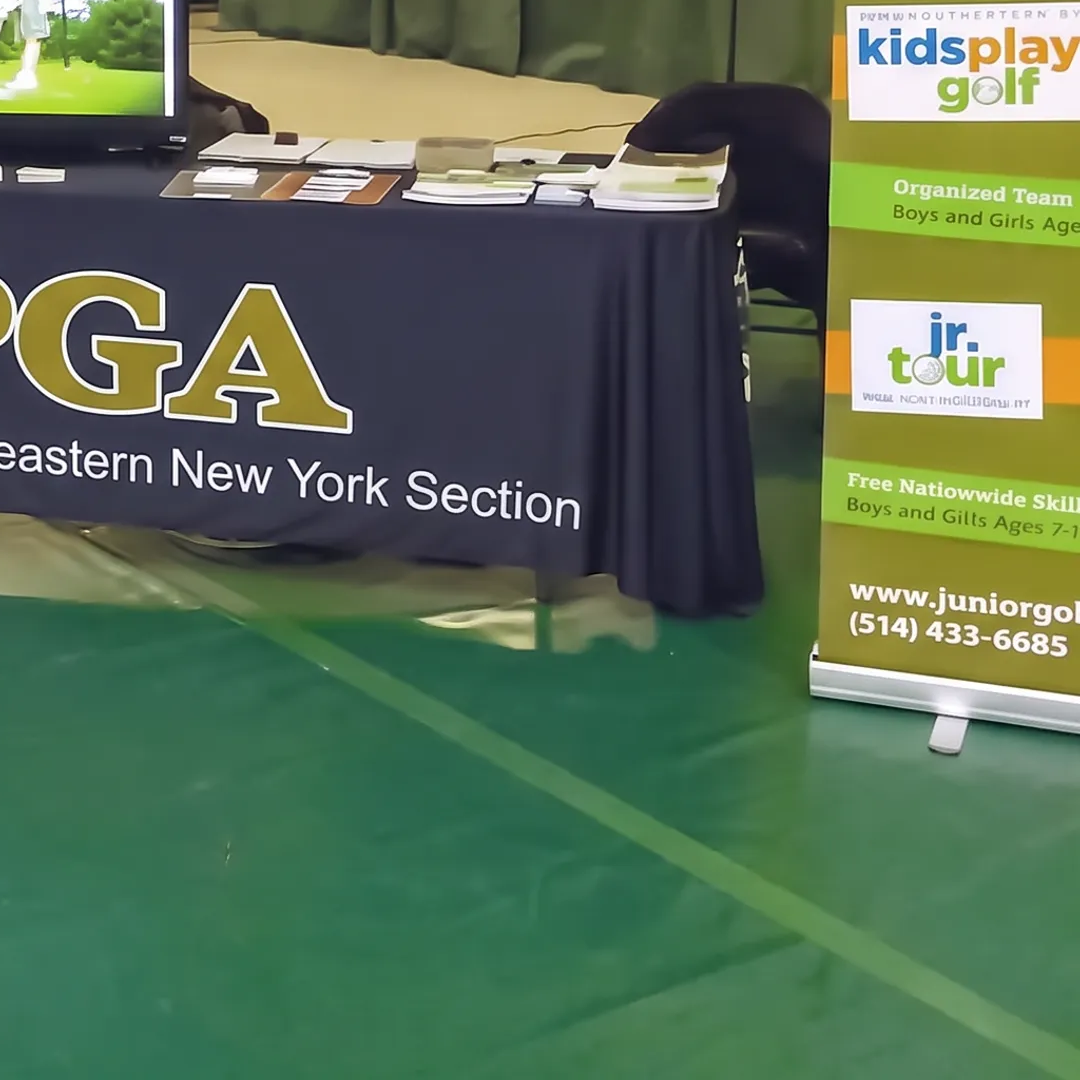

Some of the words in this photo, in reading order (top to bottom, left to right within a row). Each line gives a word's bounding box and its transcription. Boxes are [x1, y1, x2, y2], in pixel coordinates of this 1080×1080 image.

[858, 27, 1080, 72] kidsplay
[937, 67, 1040, 113] golf
[893, 179, 1006, 203] Organized
[1012, 187, 1073, 207] Team
[893, 204, 938, 225] Boys
[945, 211, 983, 226] and
[989, 213, 1034, 230] Girls
[1042, 217, 1080, 236] Age
[930, 311, 979, 358] jr.
[887, 347, 1005, 387] tour
[171, 449, 273, 495] New
[287, 458, 389, 508] York
[405, 469, 582, 530] Section
[847, 472, 893, 492] Free
[847, 497, 892, 518] Boys
[898, 506, 935, 521] and
[993, 516, 1044, 536] Ages
[849, 611, 918, 643] (514)
[925, 621, 1069, 657] 433-6685
